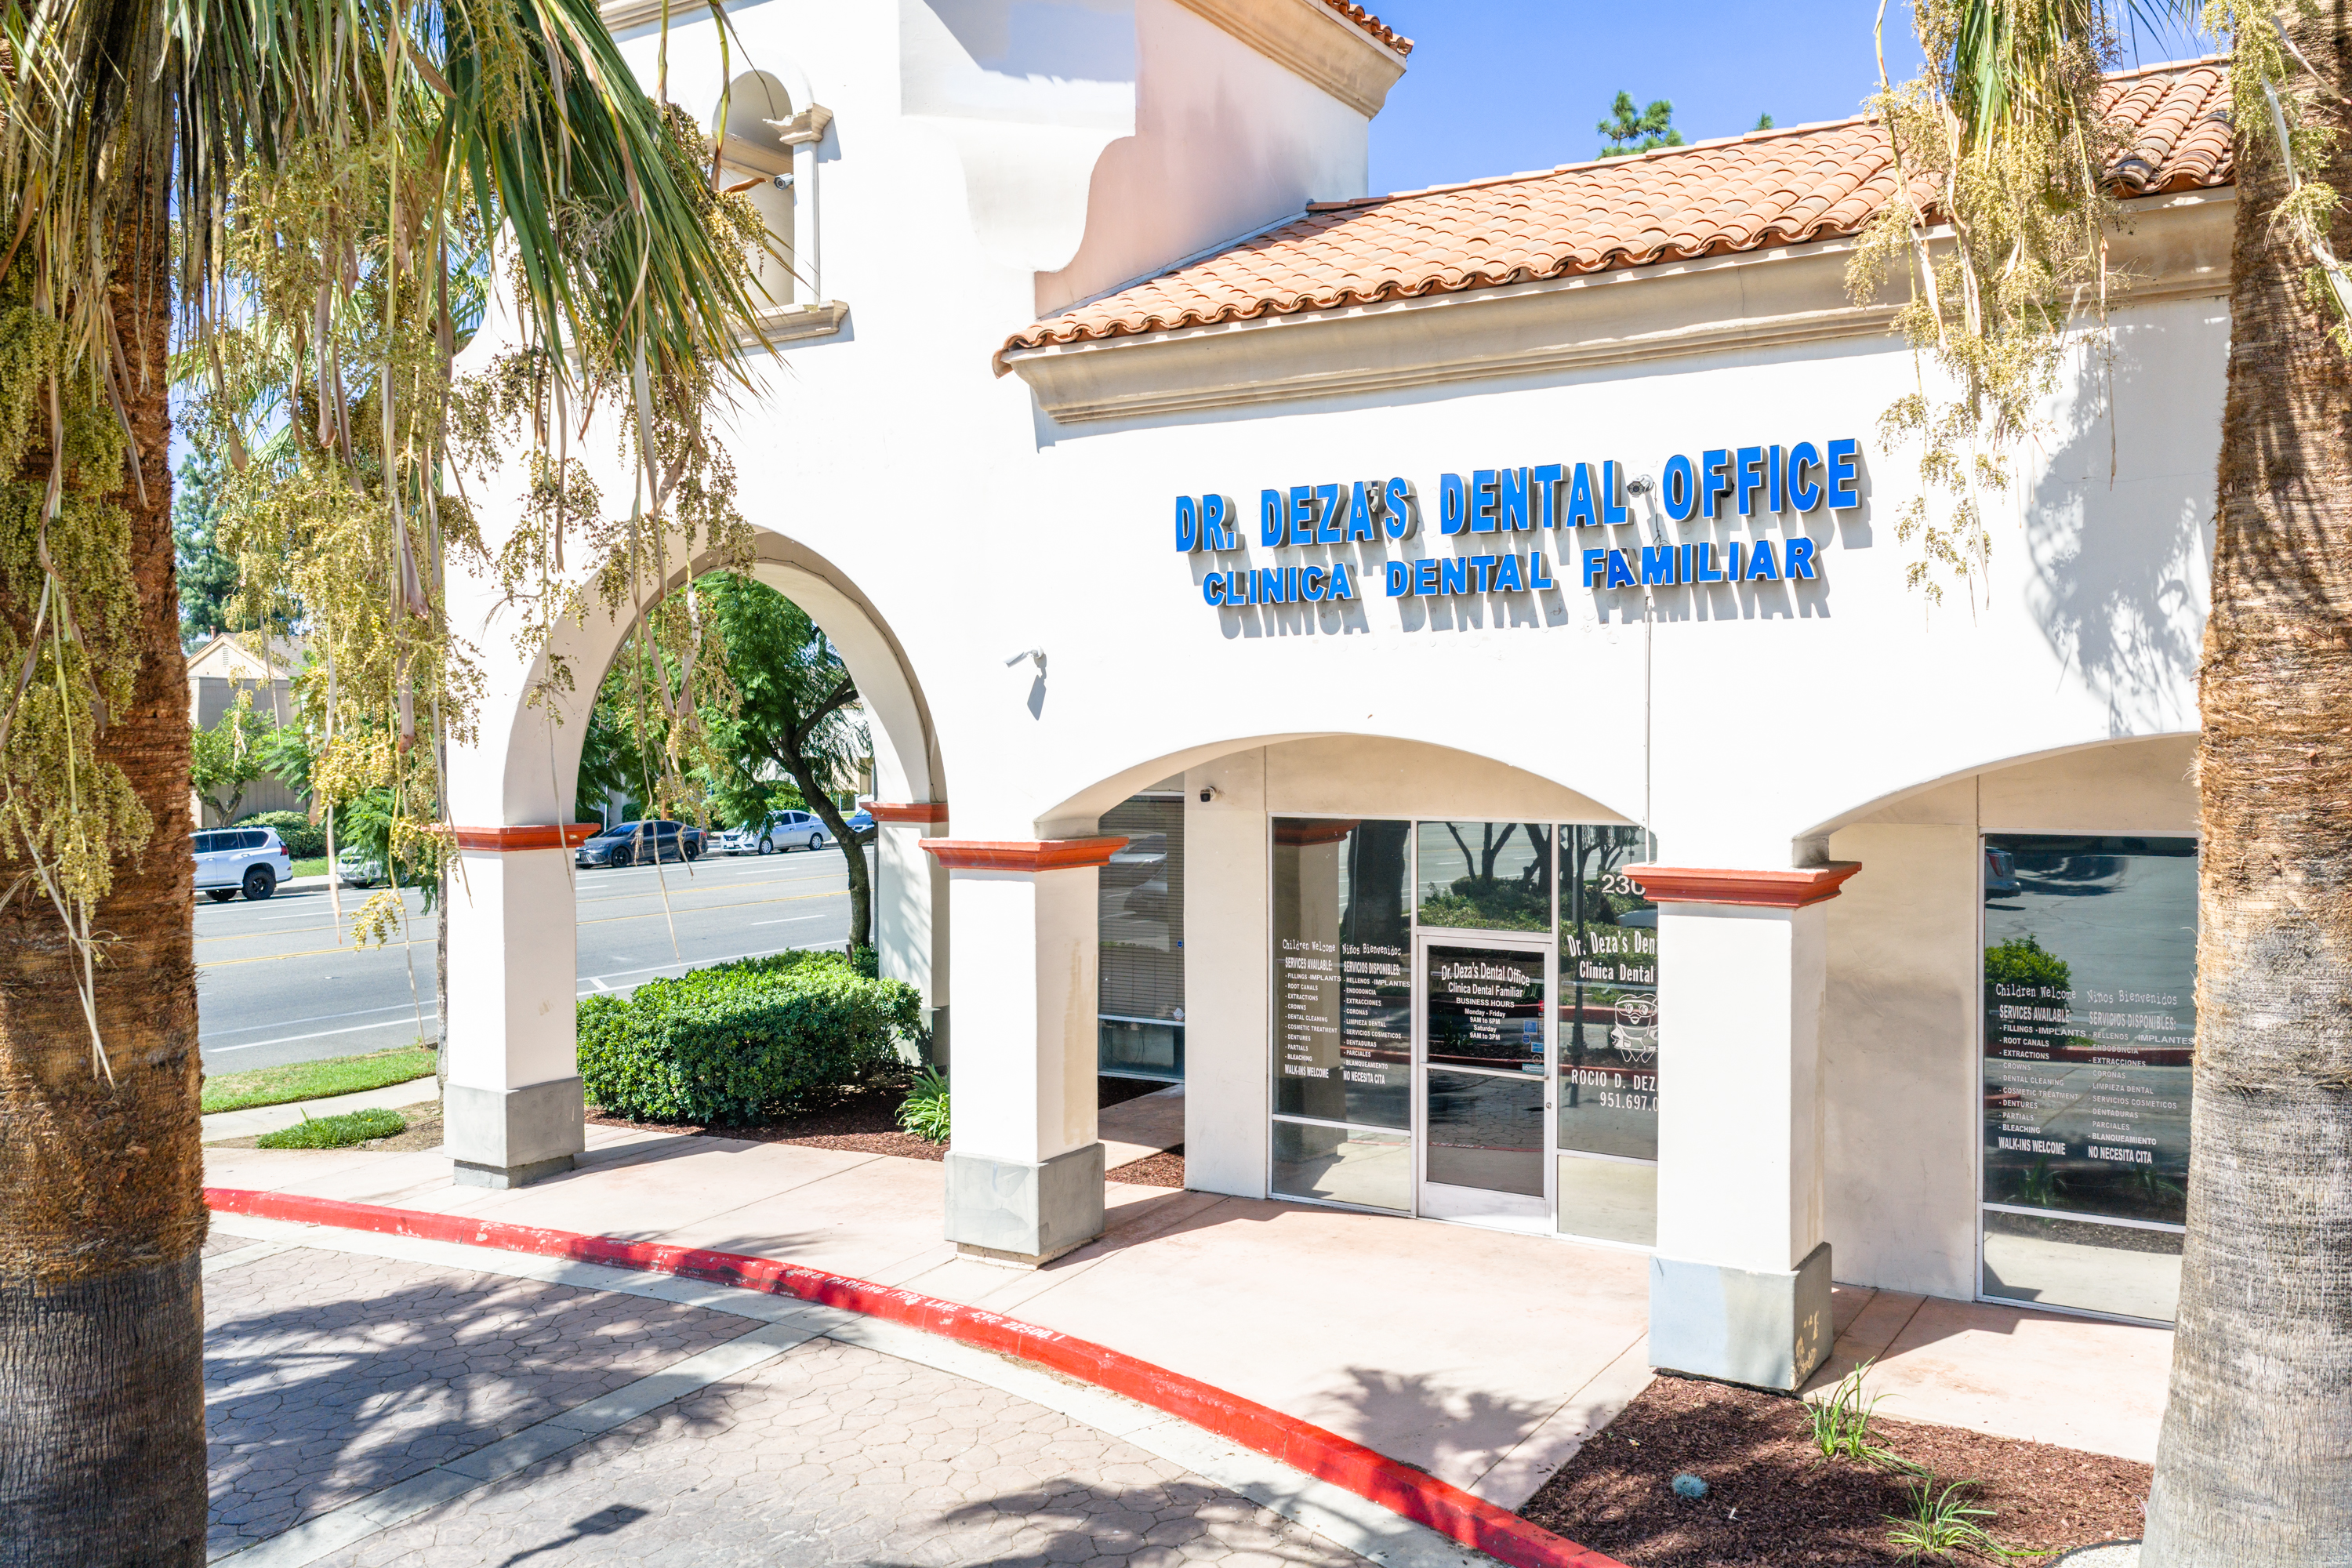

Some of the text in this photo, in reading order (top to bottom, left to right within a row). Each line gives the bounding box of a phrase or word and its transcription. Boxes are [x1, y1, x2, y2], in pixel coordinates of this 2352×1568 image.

[1174, 438, 1861, 553] DR. DEZA'S DENTAL OFFICE
[1203, 536, 1821, 607] CLINICA DENTAL FAMILIAR
[1283, 939, 1335, 953] Children Welcome
[1567, 935, 1586, 956] Dr.
[1591, 931, 1628, 954] Deza's
[1285, 957, 1332, 971] SERVICES AVAILABLE:
[1344, 961, 1400, 976] SERVICIOS DISPONIBLES:
[1580, 960, 1653, 982] Clinica Dental
[1442, 962, 1530, 986] Dr. Deza's Dental Office
[1448, 982, 1523, 997] Clinica Dental Familiar
[1996, 983, 2076, 1000] Children Welcome
[1456, 997, 1489, 1006] BUSINESS
[2119, 989, 2177, 1005] Bienvenidos
[1999, 1004, 2071, 1023] SERVICES AVAILABLE:
[2089, 1011, 2176, 1030] SERVICIOS DISPONIBLES:
[2093, 1032, 2129, 1040] RELLENOS
[2003, 1050, 2049, 1059] EXTRACTIONS
[2092, 1044, 2138, 1054] ENDODONCIA
[1346, 1060, 1388, 1069] BLANQUEAMIENTO
[2003, 1062, 2031, 1071] CROWNS
[2092, 1057, 2146, 1067] EXTRACCIONES
[1285, 1064, 1329, 1078] WALK-INS WELCOME
[1344, 1071, 1385, 1085] NO NECESITA CITA
[2092, 1070, 2125, 1079] CORONAS
[1572, 1069, 1658, 1091] ROCIO D. DEZ
[2003, 1075, 2063, 1086] DENTAL CLEANING
[2092, 1083, 2124, 1091] LIMPIEZA
[2003, 1087, 2078, 1099] COSMETIC TREATMENT
[2003, 1099, 2038, 1109] DENTURES
[2092, 1095, 2176, 1109] SERVICIOS COSMETICOS
[2003, 1112, 2034, 1120] PARTIALS
[2092, 1109, 2138, 1119] DENTADURAS
[2002, 1124, 2040, 1134] BLEACHING
[2092, 1121, 2129, 1130] PARCIALES
[1998, 1136, 2065, 1155] WALK-INS WELCOME
[2092, 1133, 2156, 1145] BLANQUEAMIENTO
[2088, 1145, 2152, 1163] NO NECESITA CITA
[826, 1276, 887, 1294] PARKING
[924, 1299, 964, 1312] LANE
